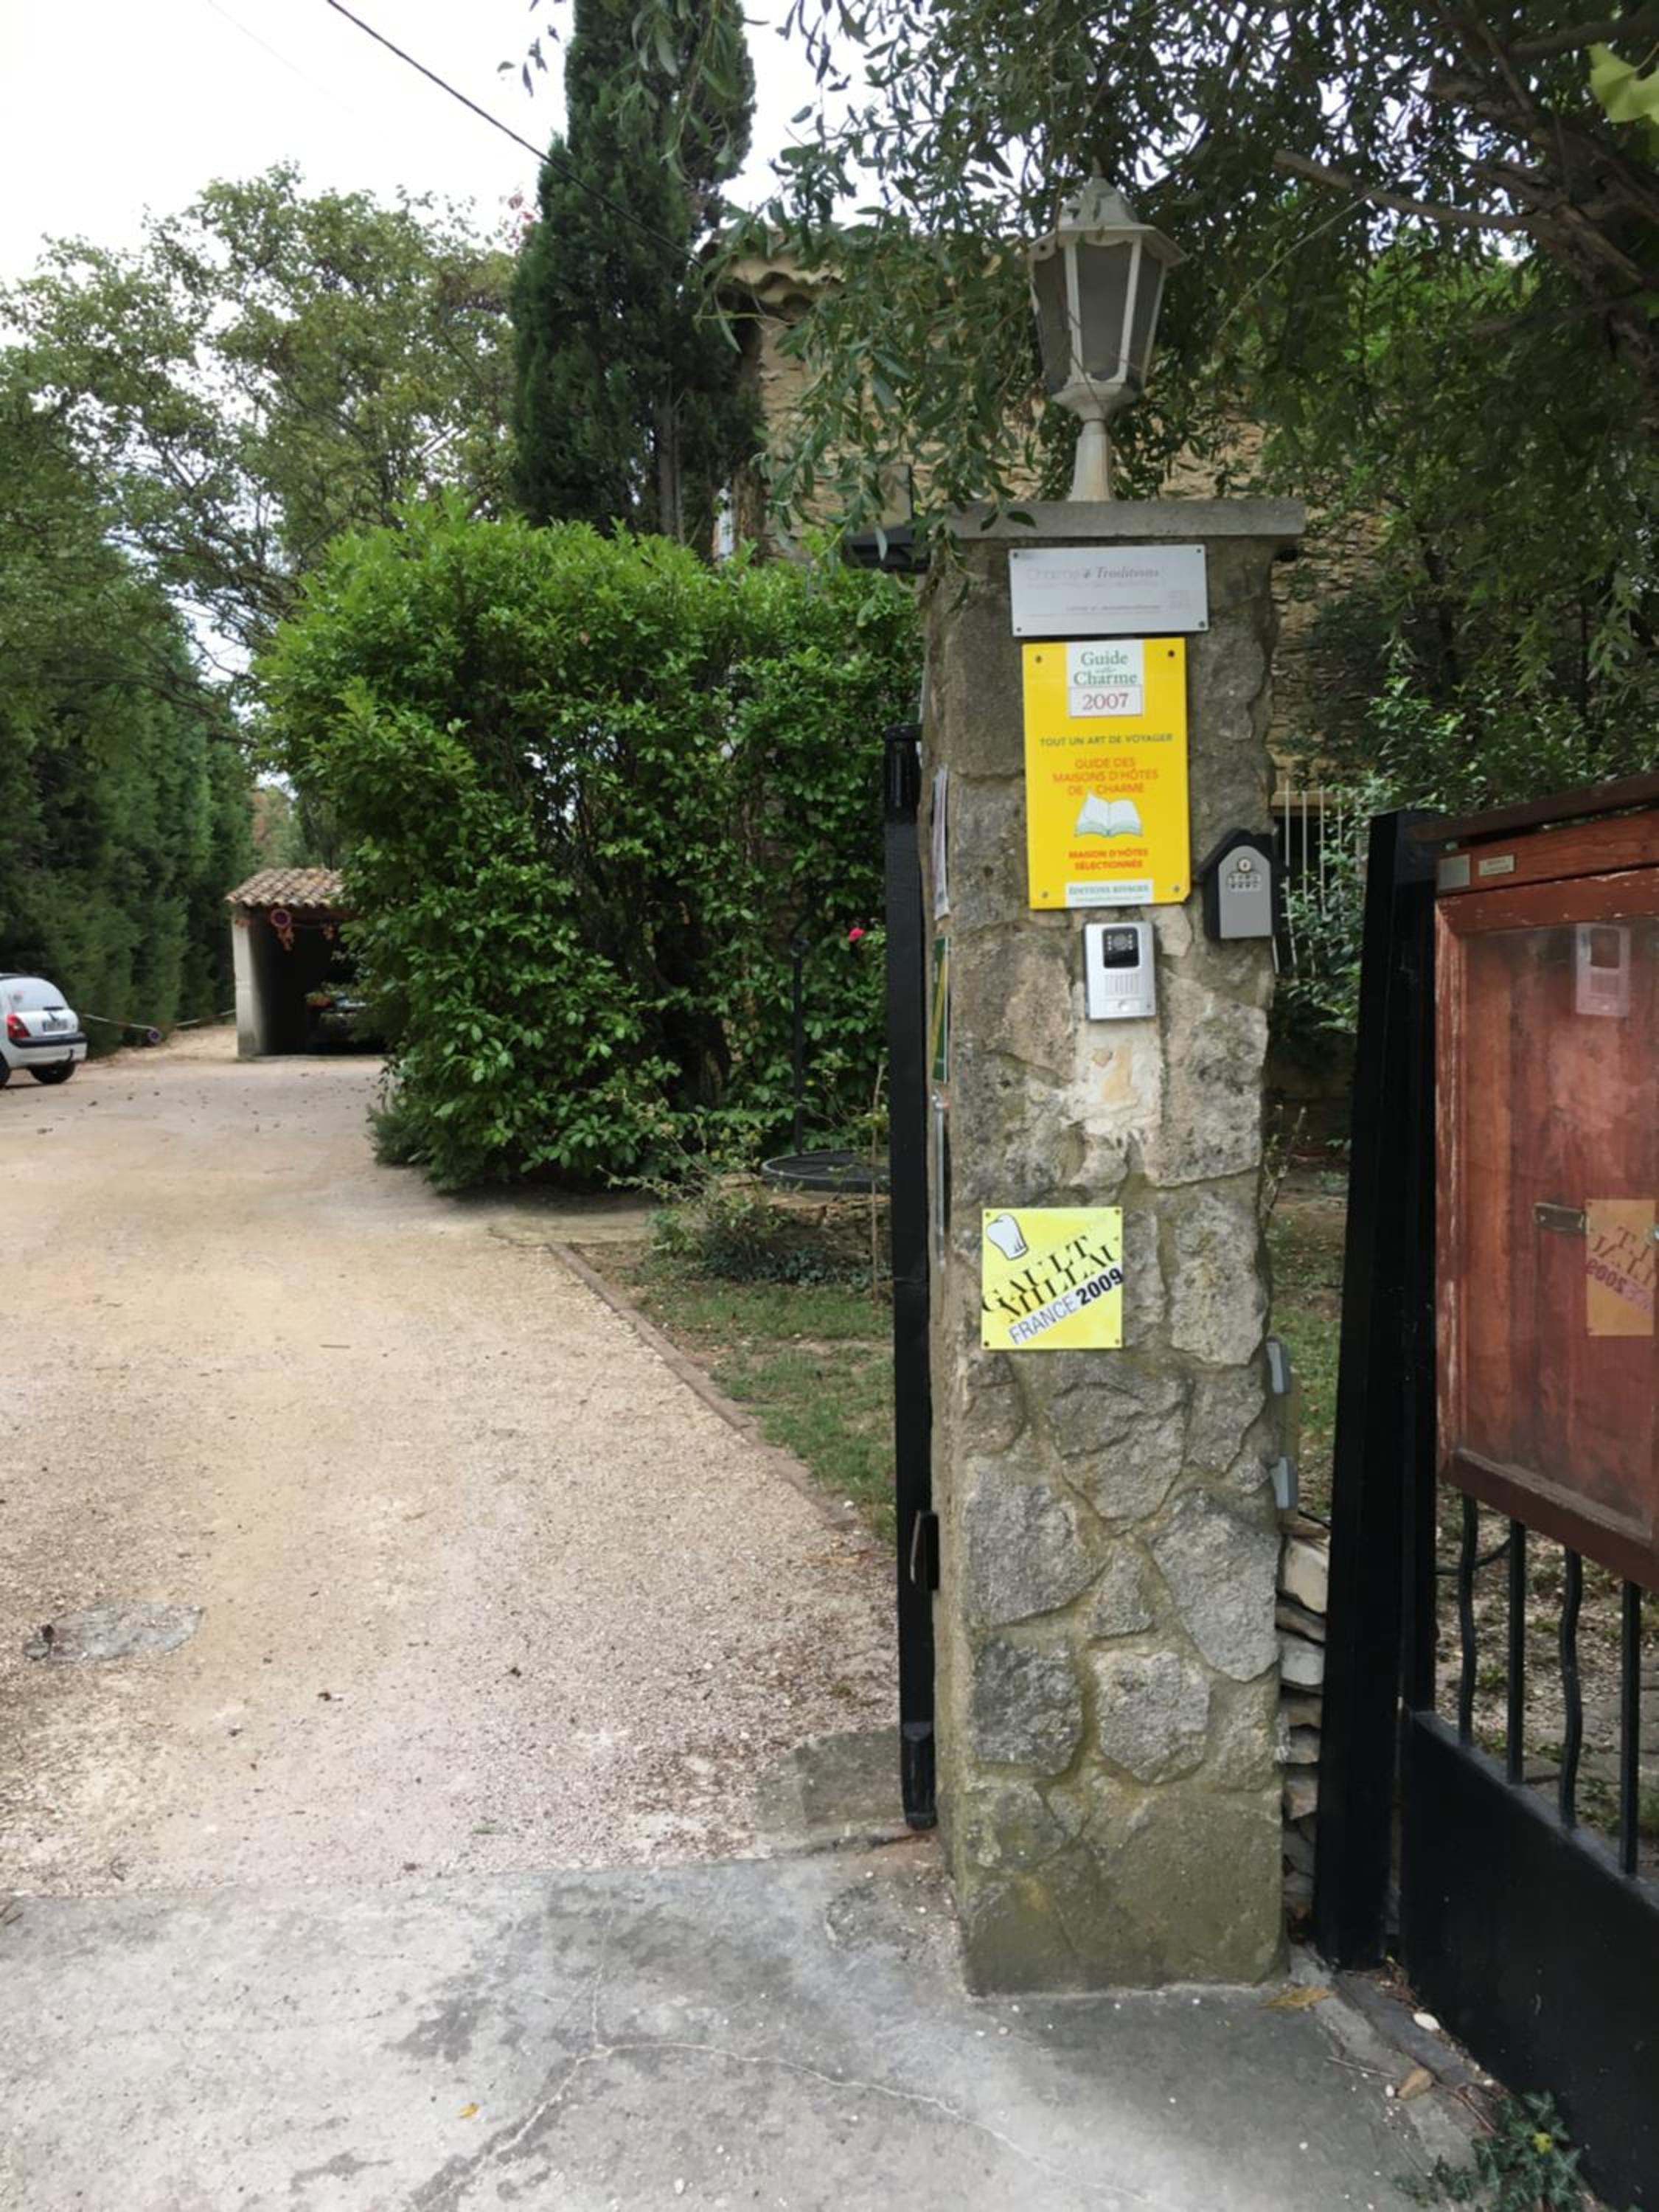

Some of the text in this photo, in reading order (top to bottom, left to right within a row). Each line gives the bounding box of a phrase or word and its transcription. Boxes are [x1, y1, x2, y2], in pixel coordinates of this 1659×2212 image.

[1080, 650, 1130, 666] Guide
[1073, 671, 1138, 686] Charme
[1082, 692, 1130, 711] 2007
[1040, 733, 1173, 747] TOUT UN ART DE VOYAGER
[1074, 757, 1135, 768] GUIDE DES
[1052, 771, 1106, 782] MAISONS
[1068, 782, 1144, 796] DE CHARME
[1009, 1267, 1124, 1344] FRANCE 2009
